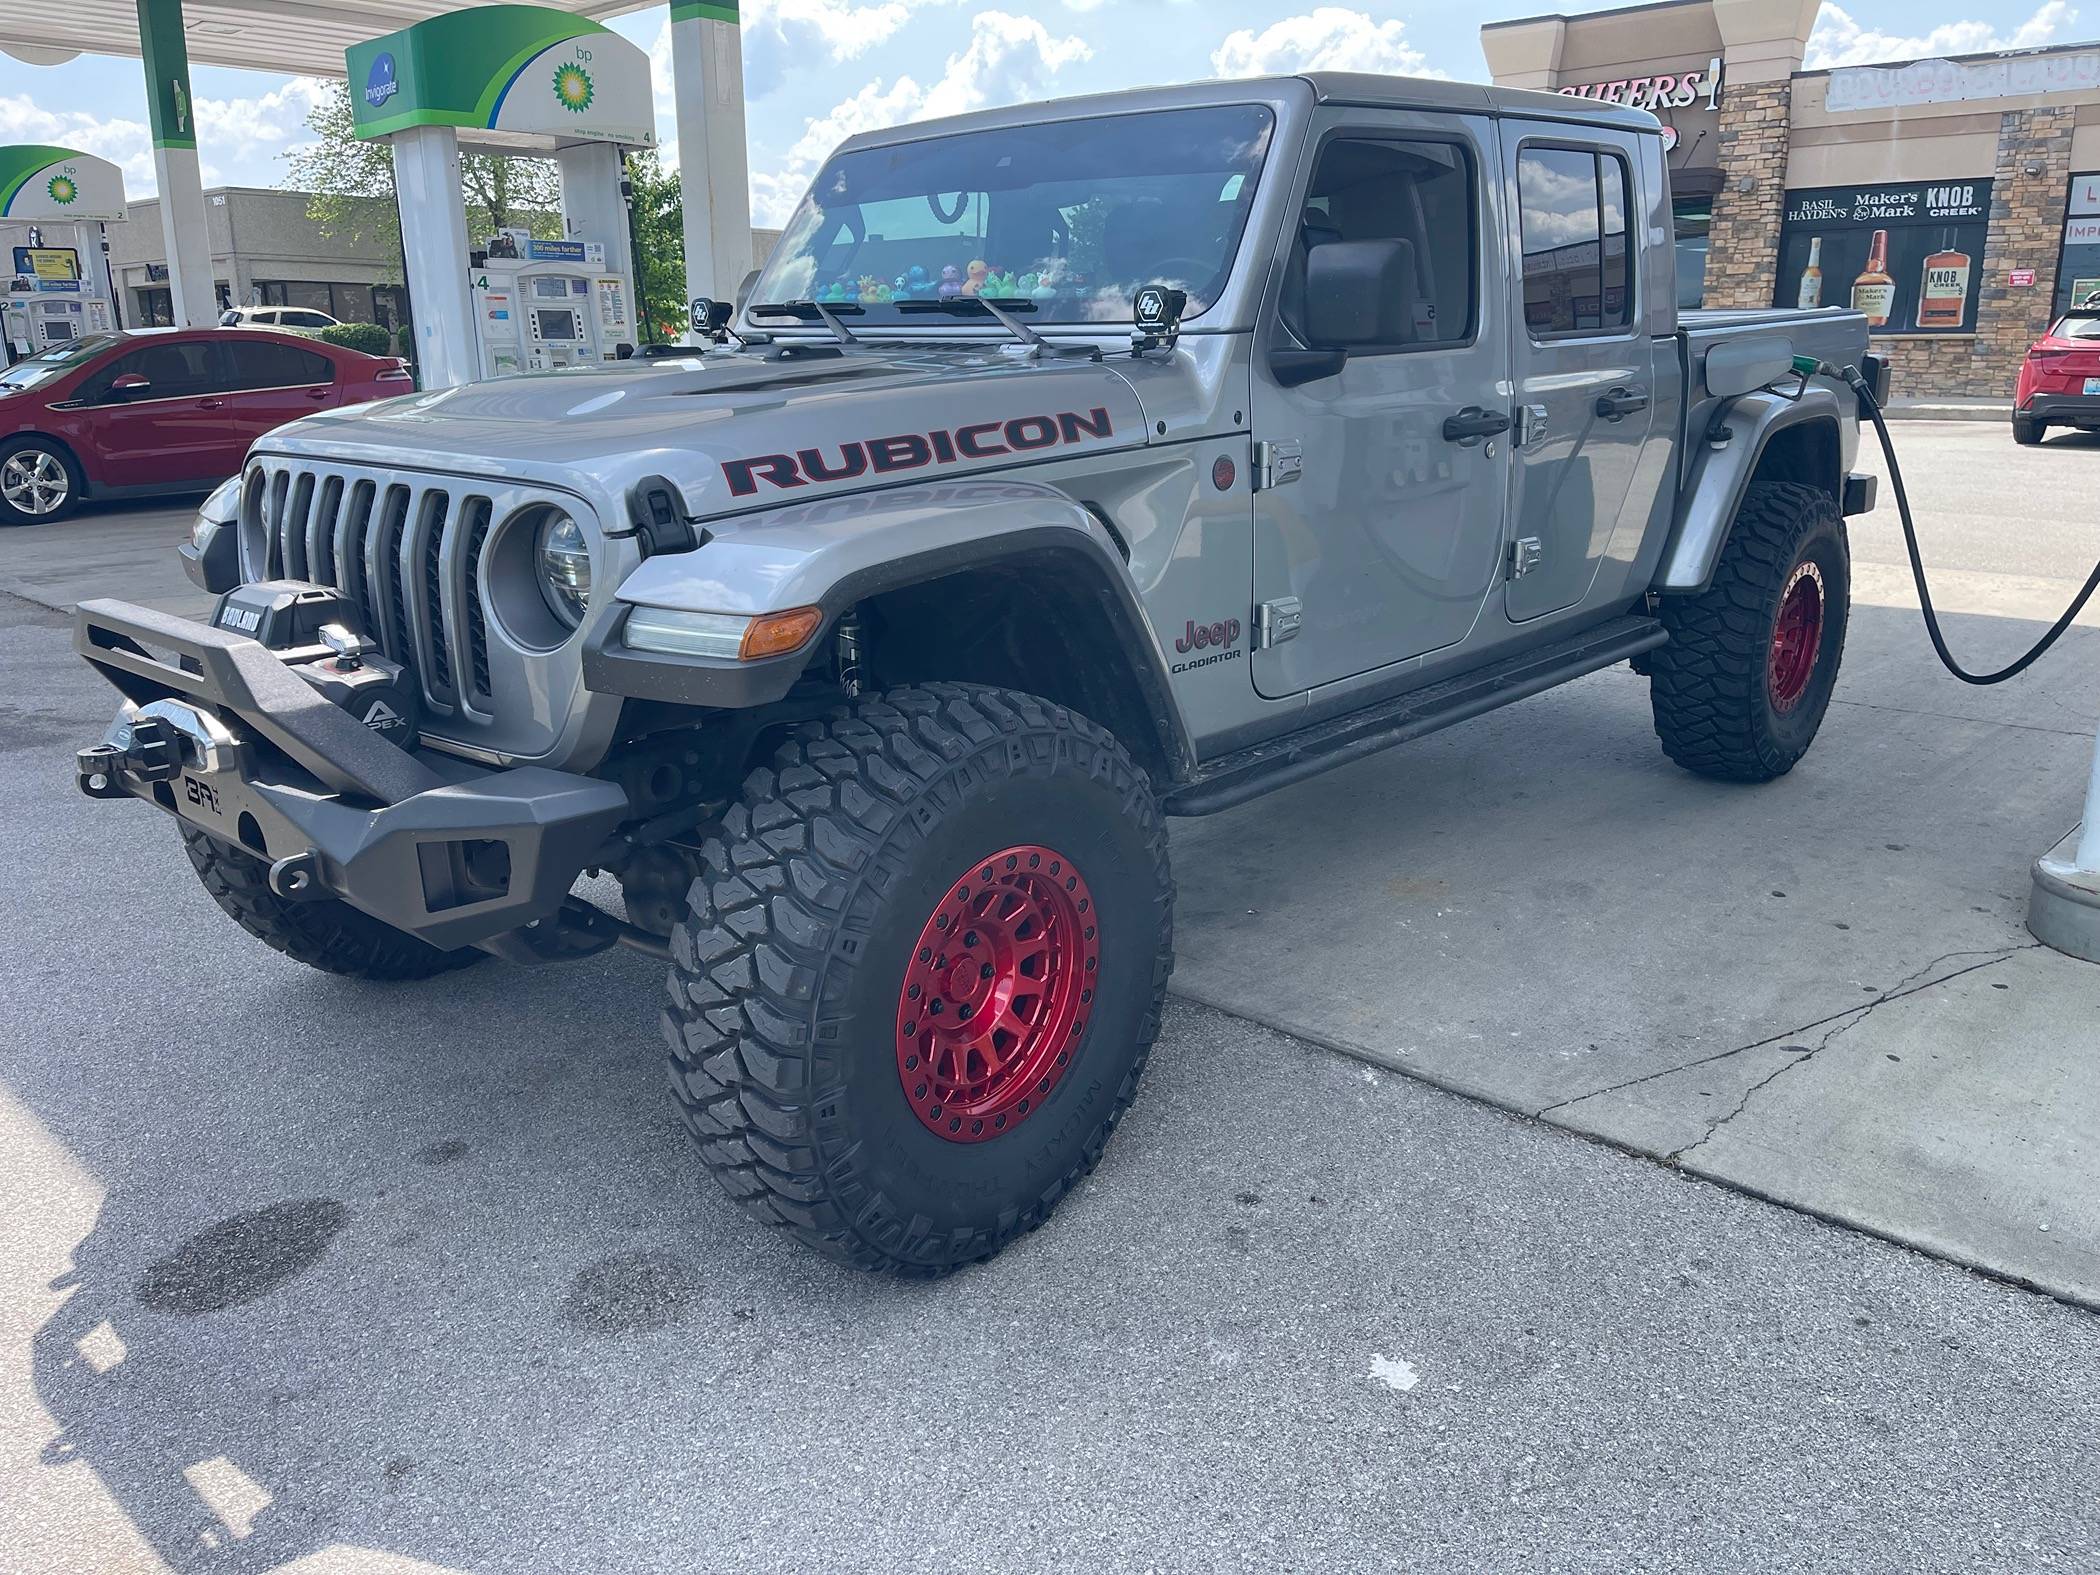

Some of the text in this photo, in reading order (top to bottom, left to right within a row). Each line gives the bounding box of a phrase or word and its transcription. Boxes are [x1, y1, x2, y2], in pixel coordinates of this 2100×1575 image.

[576, 46, 592, 63] bp
[365, 80, 397, 101] Invigorate
[1558, 72, 1701, 111] EERS
[643, 132, 651, 143] 4
[64, 165, 77, 175] bp
[1854, 193, 1918, 206] Maker's
[1926, 186, 1974, 208] KNOB
[1802, 200, 1836, 210] BASIL
[1870, 205, 1915, 218] Mark
[1930, 207, 1978, 217] CREEK
[1788, 208, 1847, 221] HAYDEN'S
[477, 276, 490, 290] 4
[1929, 270, 1957, 283] KNOB
[0, 302, 9, 311] 2
[720, 407, 1113, 497] RUBICON
[221, 605, 260, 632] BADLAND
[1175, 618, 1240, 653] Jeep
[1171, 650, 1241, 674] GLADIATOR
[362, 699, 407, 730] APEX
